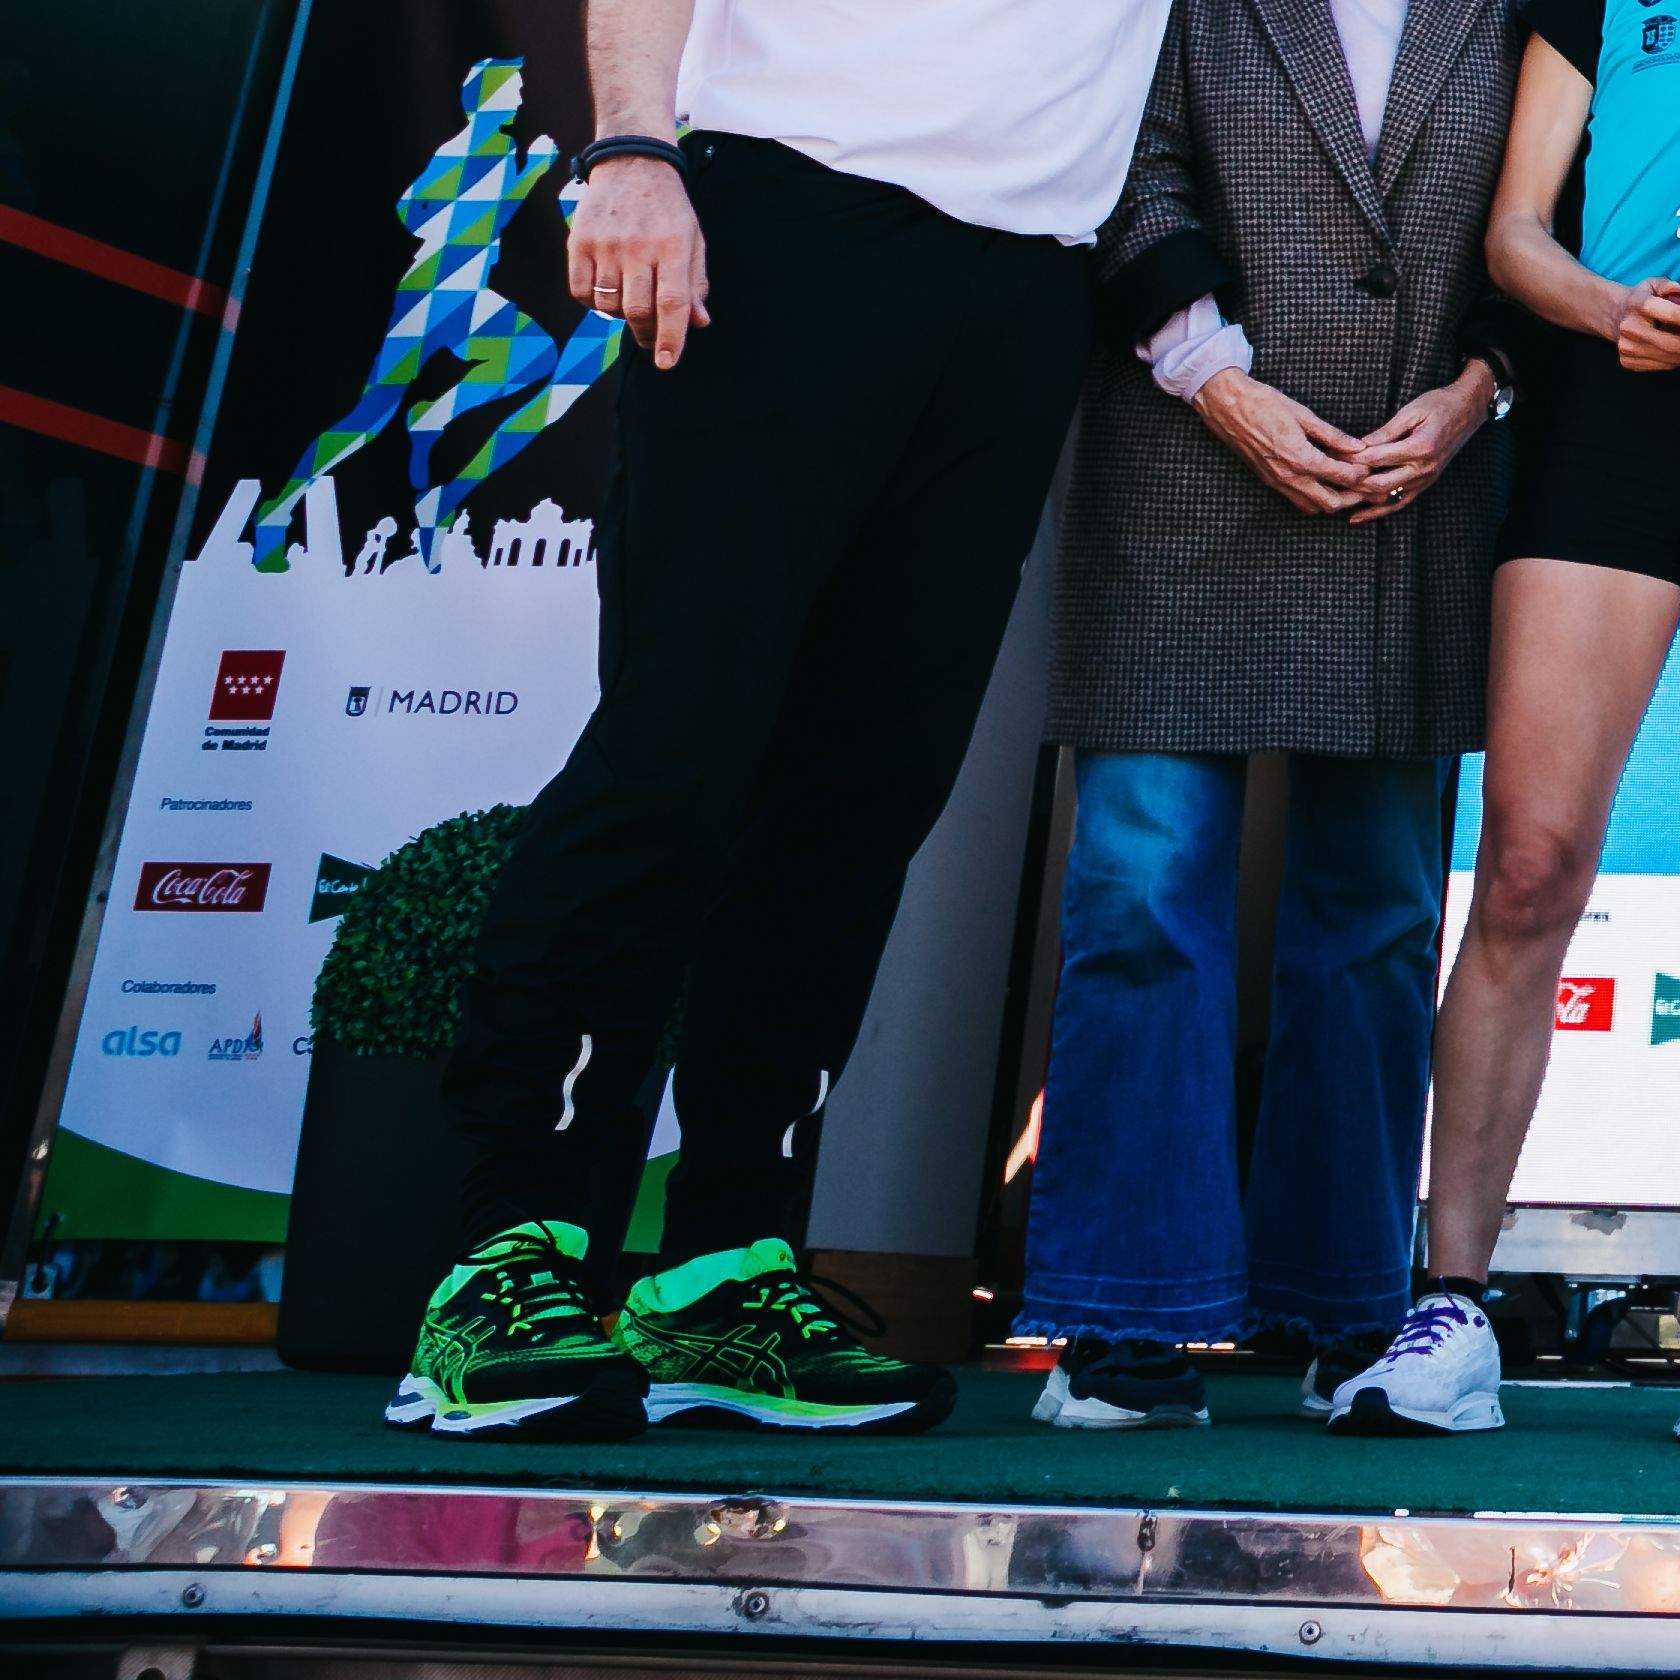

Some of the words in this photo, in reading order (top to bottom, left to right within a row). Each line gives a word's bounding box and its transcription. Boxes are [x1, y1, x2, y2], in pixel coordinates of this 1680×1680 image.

[388, 689, 520, 716] MADRID
[204, 726, 271, 737] Comunidad
[201, 740, 219, 751] de
[221, 739, 268, 751] Madrid
[160, 797, 253, 811] Patrocinadores
[120, 979, 217, 995] Colaboradores
[100, 1025, 183, 1057] alsa
